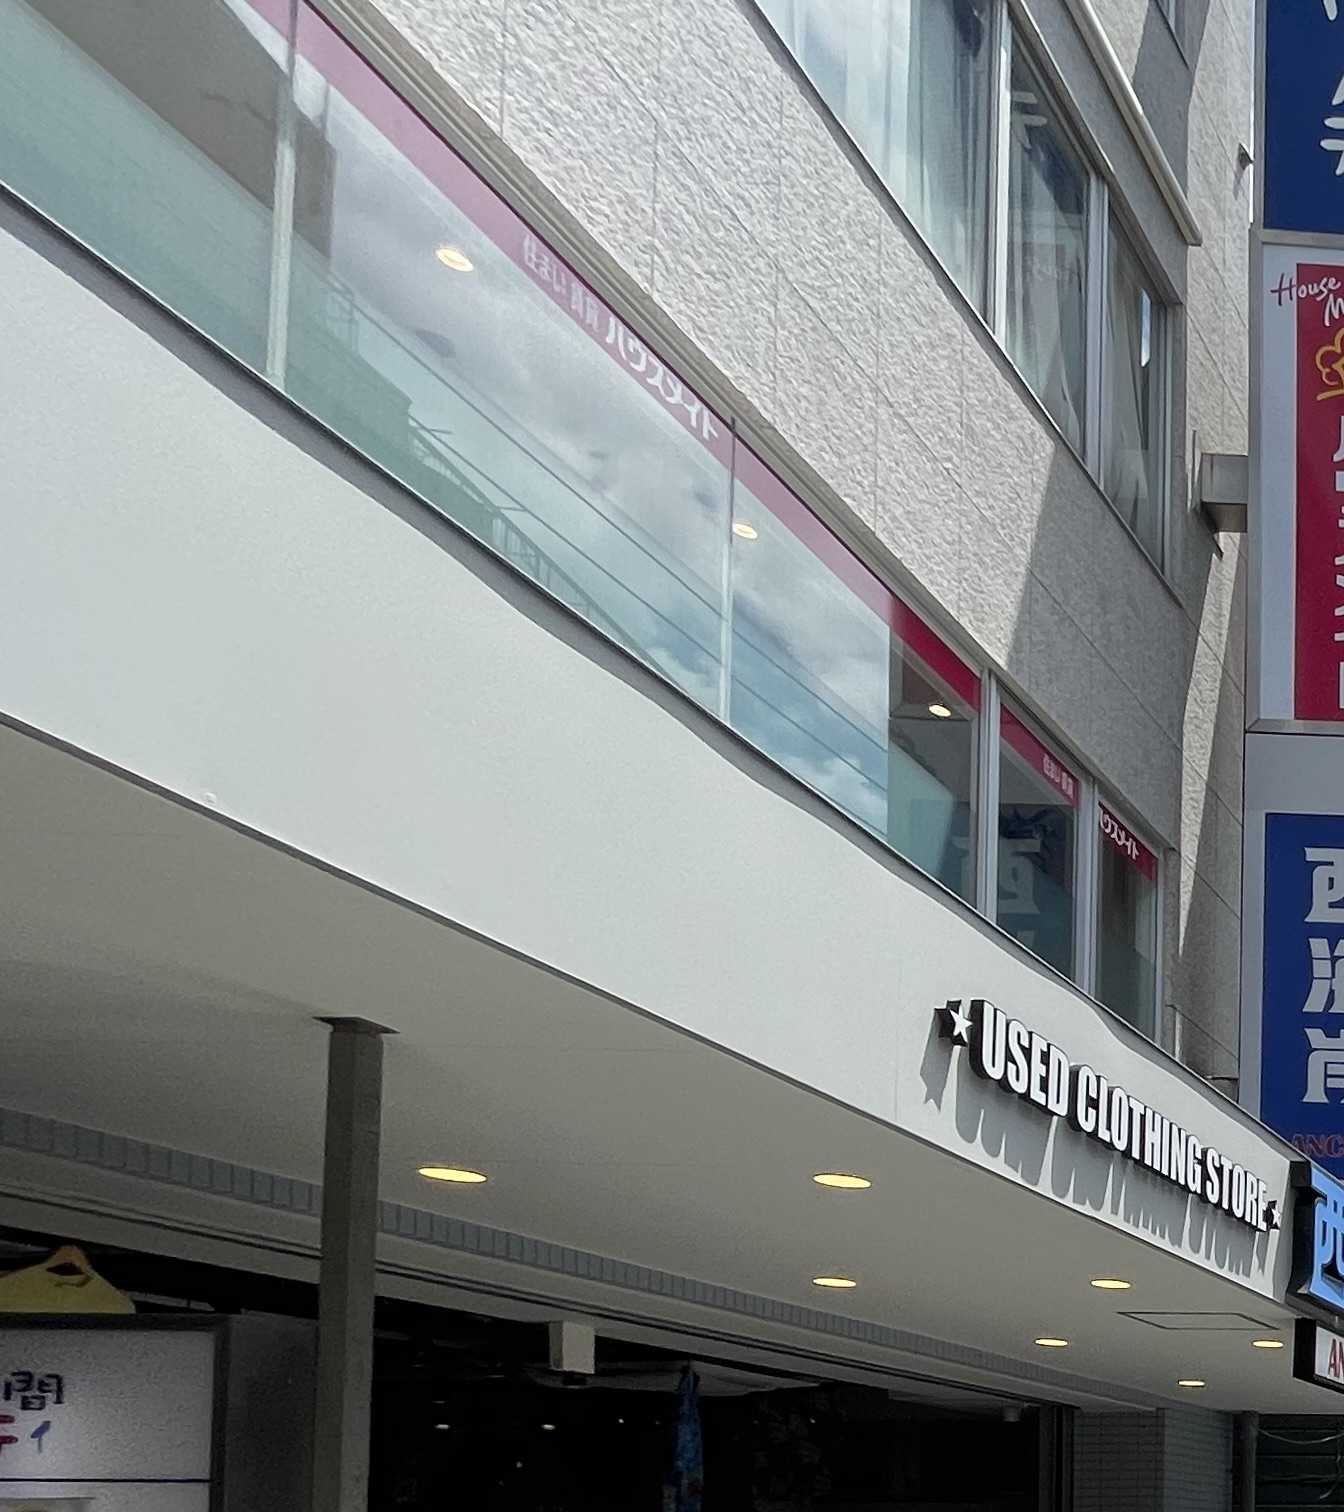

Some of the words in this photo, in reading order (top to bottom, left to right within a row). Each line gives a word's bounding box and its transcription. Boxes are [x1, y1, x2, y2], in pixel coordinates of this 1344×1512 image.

[1270, 272, 1341, 306] House
[605, 316, 719, 442] ハウスメイト
[980, 1004, 1069, 1119] USED
[1076, 1067, 1203, 1195] CLOTHING
[1205, 1148, 1268, 1232] STORE
